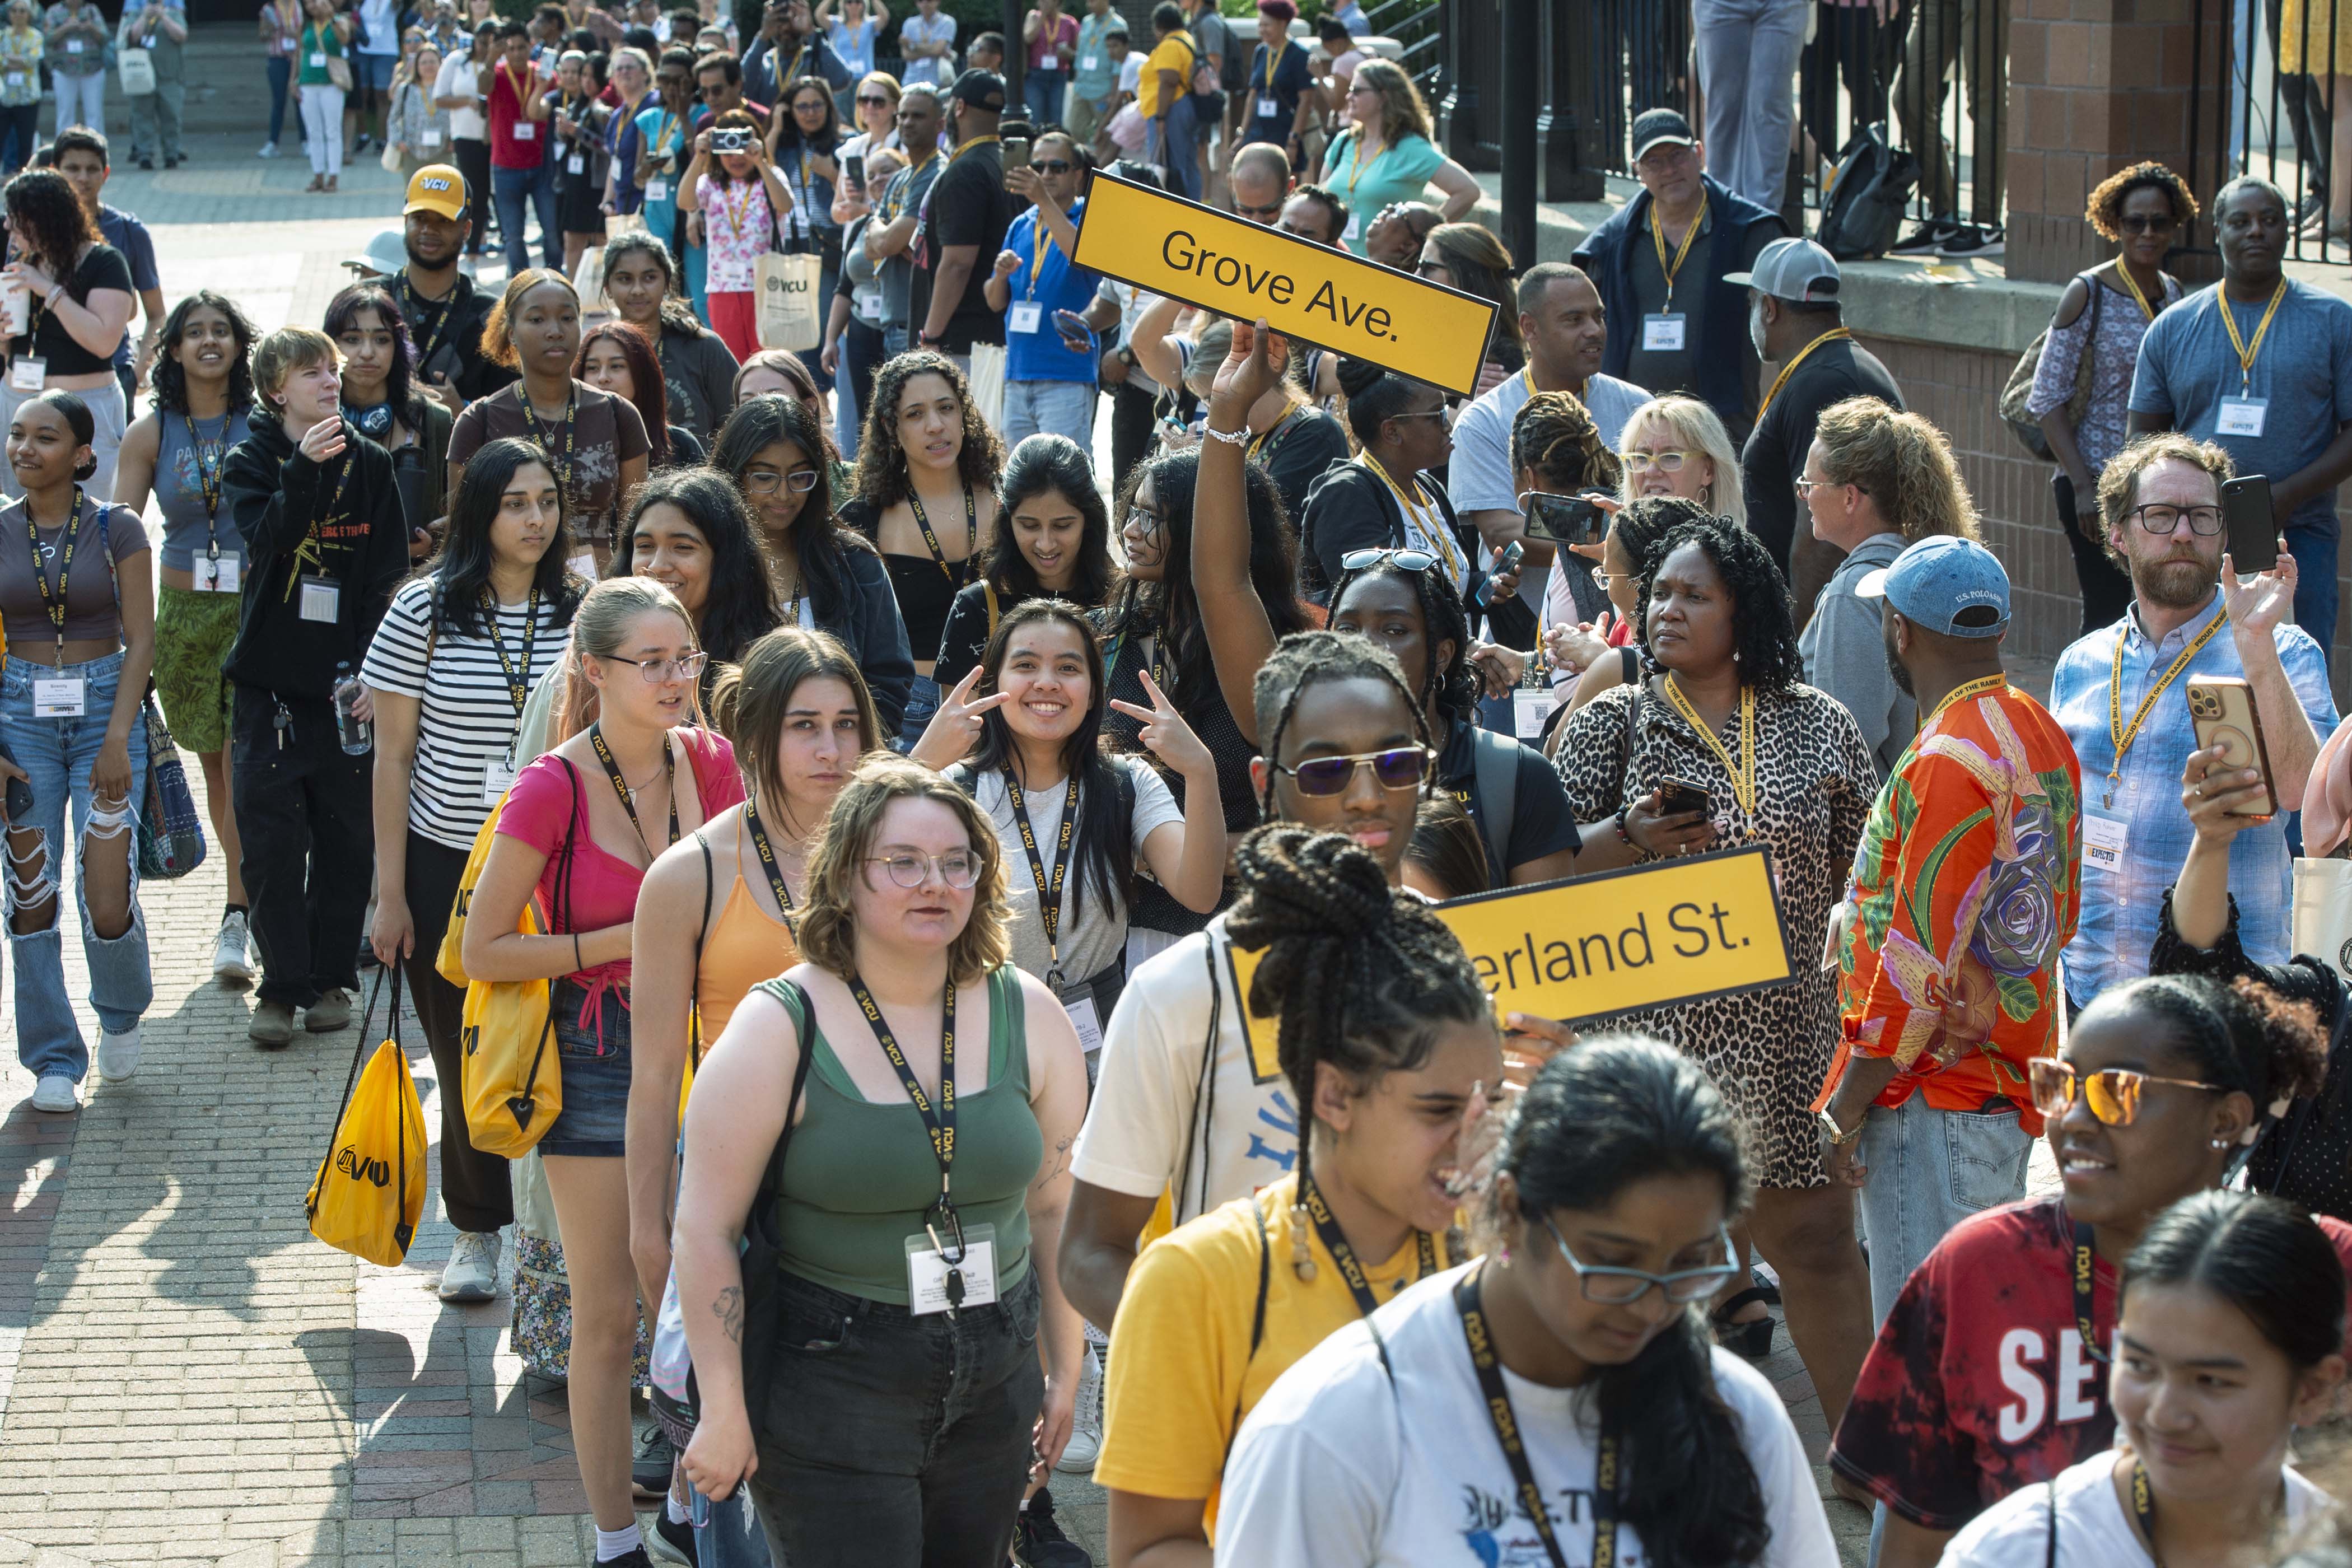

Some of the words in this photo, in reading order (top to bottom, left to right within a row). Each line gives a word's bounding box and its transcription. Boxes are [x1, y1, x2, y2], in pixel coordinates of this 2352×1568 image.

[423, 177, 451, 191] VCU
[781, 279, 807, 292] VCU
[1163, 231, 1294, 304] Grove
[1304, 280, 1398, 342] Ave.
[342, 464, 352, 477] VCU
[912, 501, 922, 516] VCU
[925, 531, 935, 545] VCU
[940, 561, 950, 576] VCU
[40, 582, 49, 597] VCU
[1956, 593, 1970, 603] U.S.
[481, 594, 489, 609] VCU
[492, 627, 501, 641] VCU
[503, 659, 513, 673] VCU
[1954, 688, 1963, 697] OF
[1963, 683, 1979, 692] THE
[1980, 678, 2001, 687] RAMILY
[2121, 725, 2136, 748] PROUD
[2135, 696, 2155, 724] MEMBER
[2154, 685, 2162, 696] OF
[2160, 674, 2172, 687] THE
[2171, 653, 2190, 675] RAMILY
[2195, 628, 2213, 647] PROUD
[2213, 611, 2228, 629] MEMB
[1667, 682, 1673, 690] OF
[1670, 687, 1680, 700] THE
[1678, 699, 1695, 718] RAMILY
[1697, 724, 1712, 741] PROUD
[1711, 740, 1729, 766] MEMBER
[1728, 763, 1735, 772] OF
[592, 735, 606, 755] VCU
[613, 775, 626, 793] VCU
[1746, 753, 1751, 762] OF
[1010, 788, 1021, 808] VCU
[1022, 829, 1034, 848] VCU
[1034, 870, 1046, 891] VCU
[1062, 822, 1071, 842] VCU
[2086, 846, 2115, 862] UNEXPECTED
[758, 841, 773, 862] VCU
[776, 886, 790, 907] VCU
[1053, 864, 1064, 883] VCU
[1471, 912, 1654, 995] erland
[1668, 902, 1750, 958] St.
[861, 998, 879, 1021] VCU
[886, 1043, 904, 1066] VCU
[912, 1088, 930, 1111] VCU
[945, 1032, 953, 1054] VCU
[944, 1080, 953, 1103] VCU
[943, 1127, 954, 1152] VCU
[1306, 1191, 1331, 1225] VCU
[1341, 1254, 1366, 1289] VCU
[2076, 1246, 2090, 1280] VCU
[1998, 1328, 2121, 1444] SE
[1464, 1312, 1488, 1352] VCU
[1491, 1398, 1515, 1438] VCU
[1522, 1483, 1546, 1522] VCU
[1599, 1452, 1616, 1491] VCU
[2135, 1480, 2149, 1514] VCU
